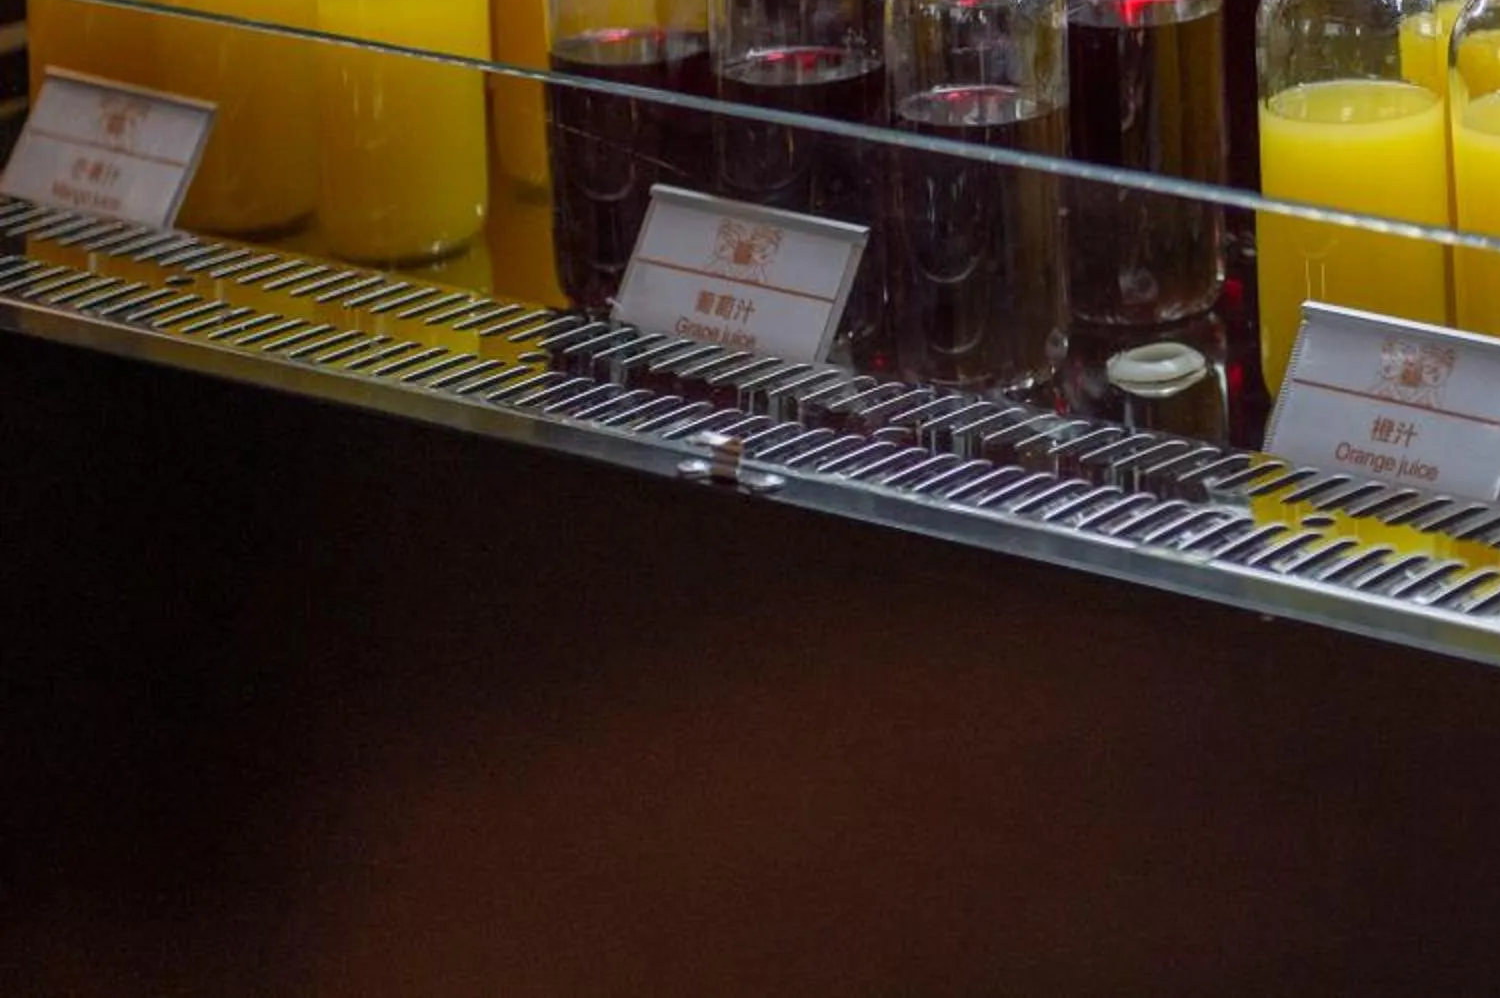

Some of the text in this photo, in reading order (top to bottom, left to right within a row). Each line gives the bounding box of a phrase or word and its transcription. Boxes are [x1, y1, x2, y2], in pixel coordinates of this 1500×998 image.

[675, 316, 757, 350] Grape juice
[1371, 415, 1418, 448] 橙汁
[1335, 441, 1439, 482] Orange juice
